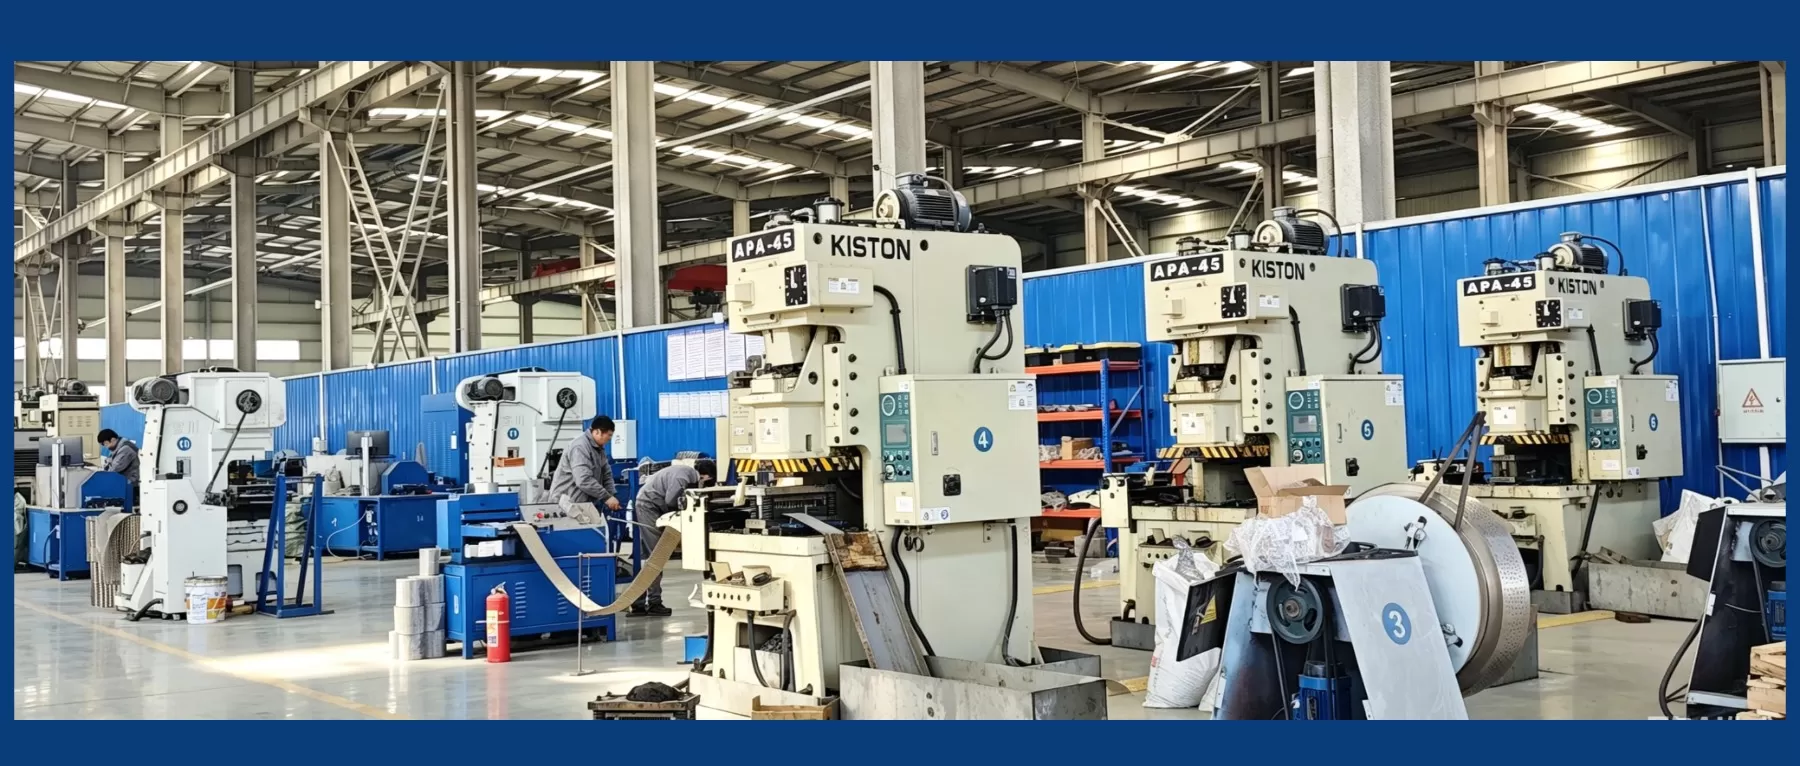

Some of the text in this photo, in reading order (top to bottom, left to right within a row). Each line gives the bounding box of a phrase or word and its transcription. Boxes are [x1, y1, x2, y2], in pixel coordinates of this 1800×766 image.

[734, 232, 793, 259] APA-45
[831, 234, 911, 261] KISTON
[1154, 257, 1221, 279] APA-45
[1252, 259, 1305, 281] KISTON
[1466, 276, 1533, 294] APA-45
[1557, 277, 1597, 295] KISTON
[978, 430, 989, 449] 4
[1364, 422, 1371, 438] 5
[1389, 610, 1406, 638] 3
